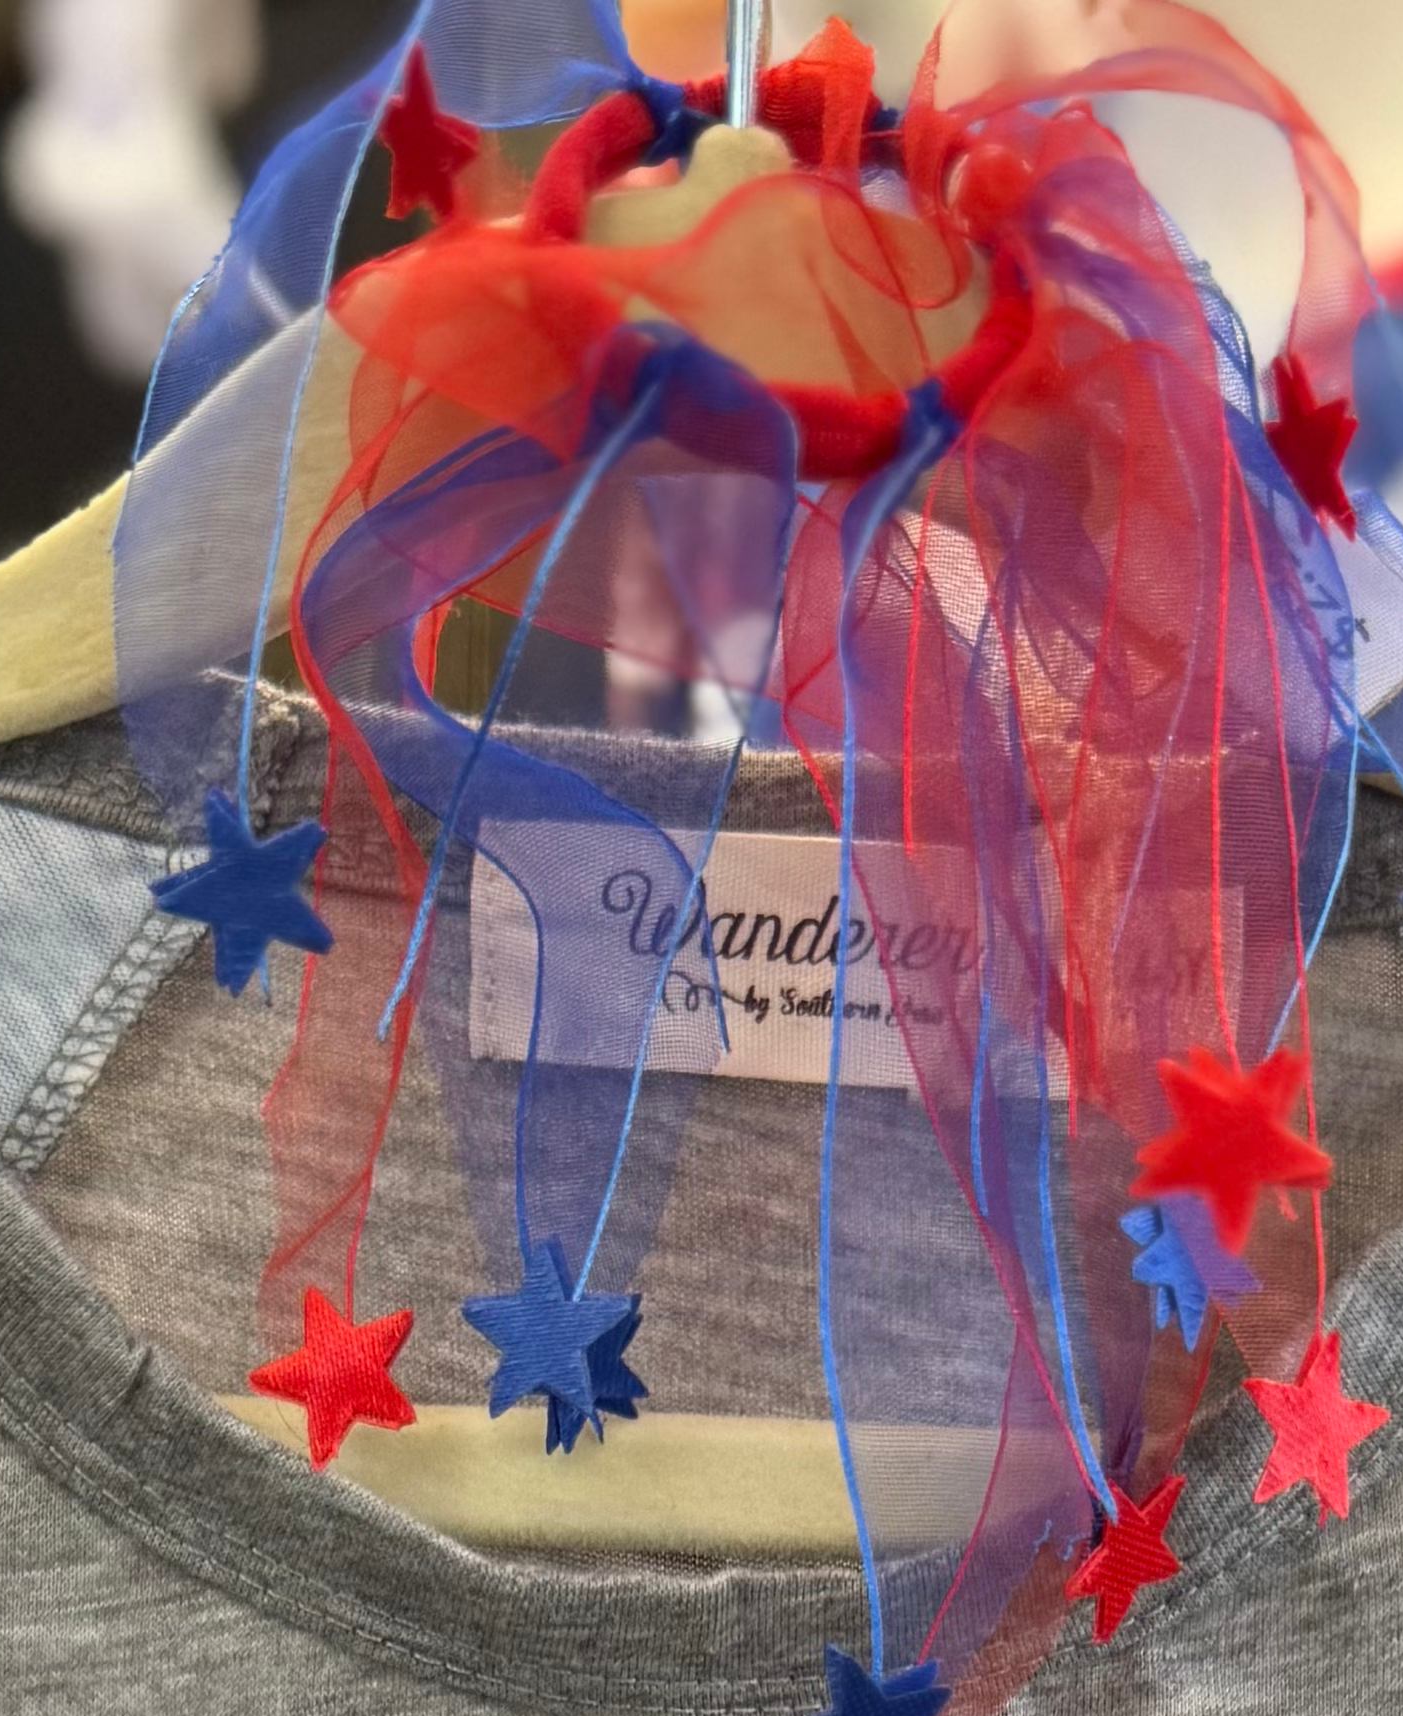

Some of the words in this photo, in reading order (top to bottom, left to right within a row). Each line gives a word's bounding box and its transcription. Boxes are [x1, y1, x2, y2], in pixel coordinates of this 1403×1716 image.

[601, 869, 981, 976] Wanderer
[743, 984, 770, 1024] by
[779, 986, 882, 1020] Soutern
